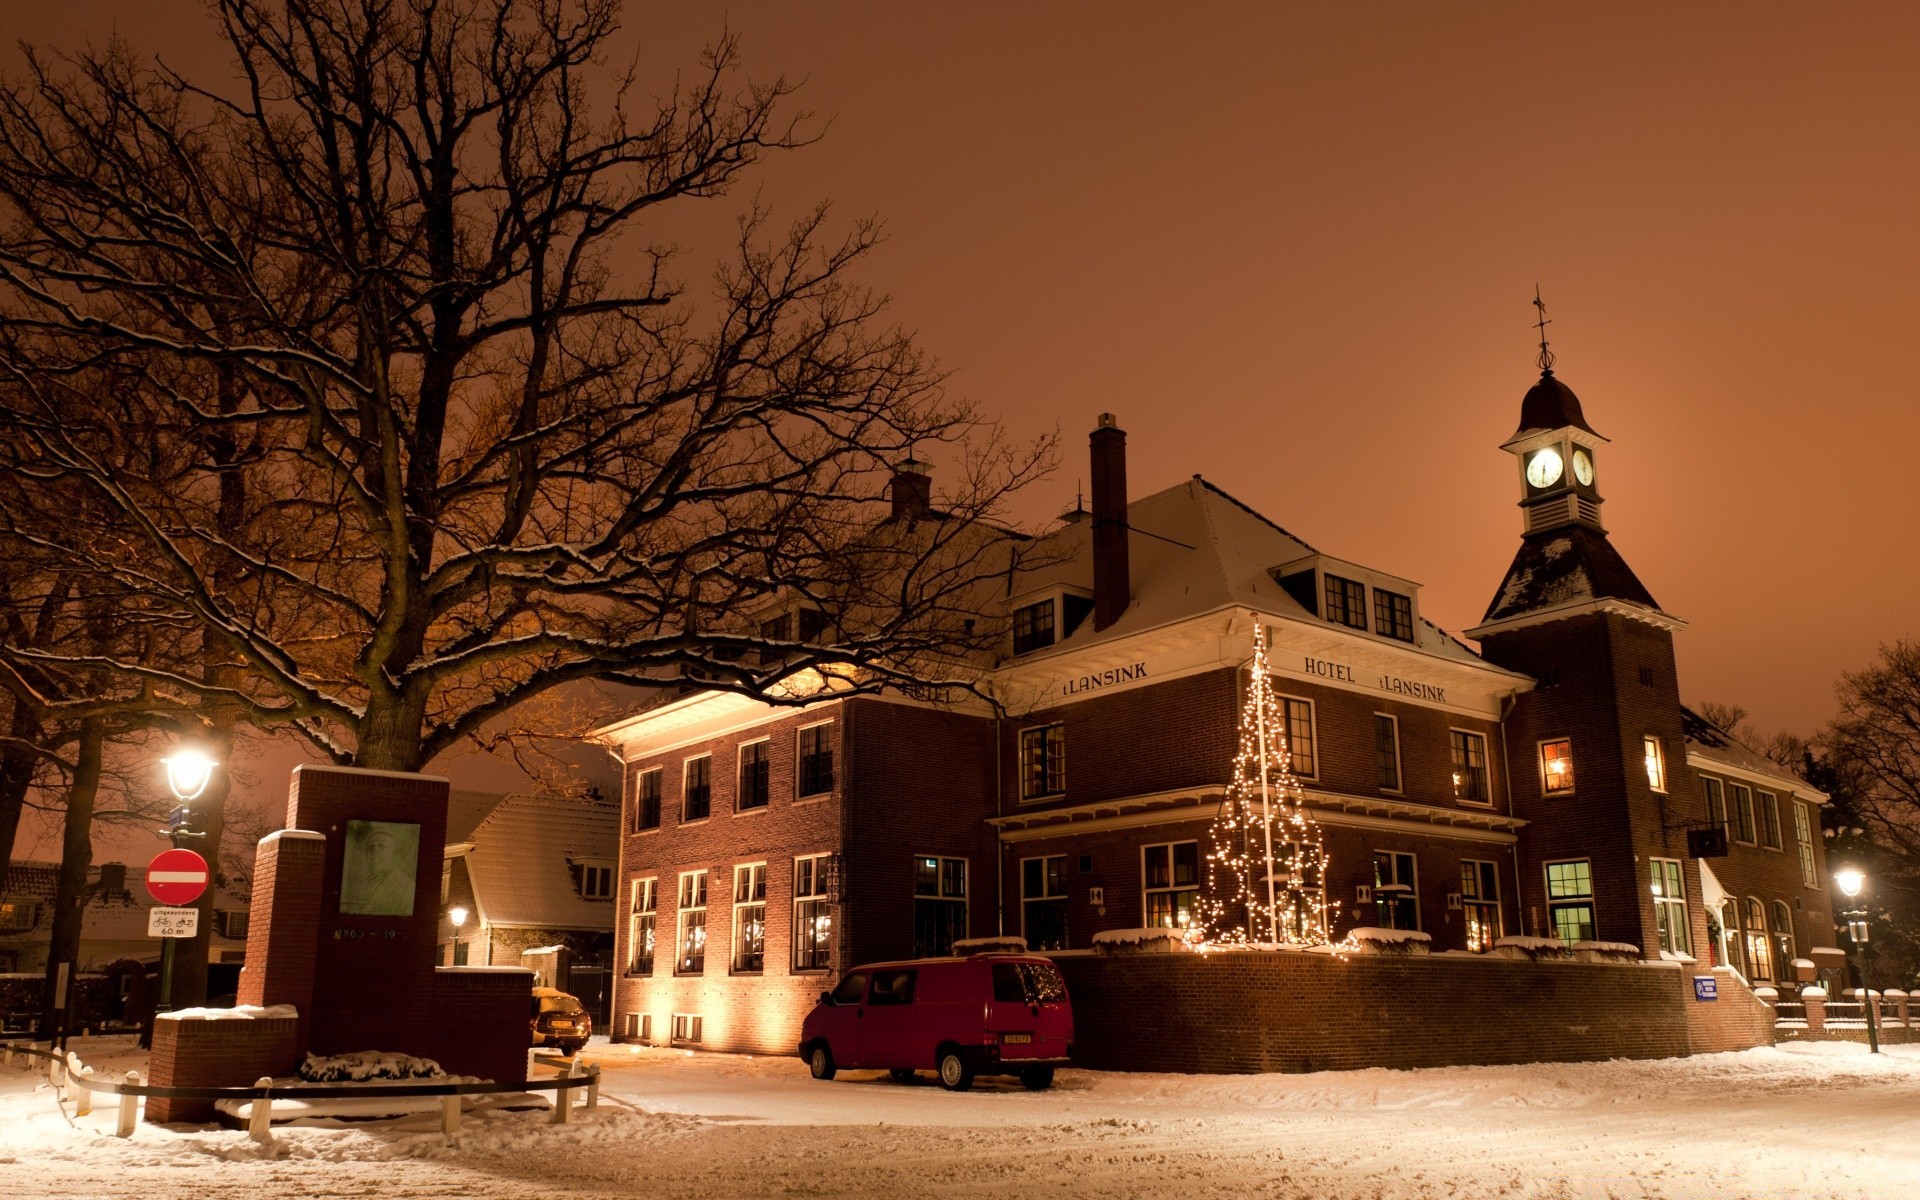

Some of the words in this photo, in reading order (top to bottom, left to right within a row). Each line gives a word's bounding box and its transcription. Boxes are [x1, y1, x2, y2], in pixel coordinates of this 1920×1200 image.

[1069, 662, 1148, 694] LANSINK
[1304, 657, 1356, 683] HOTEL
[1384, 675, 1446, 703] LANSINK
[153, 909, 196, 917] uitgezonderd
